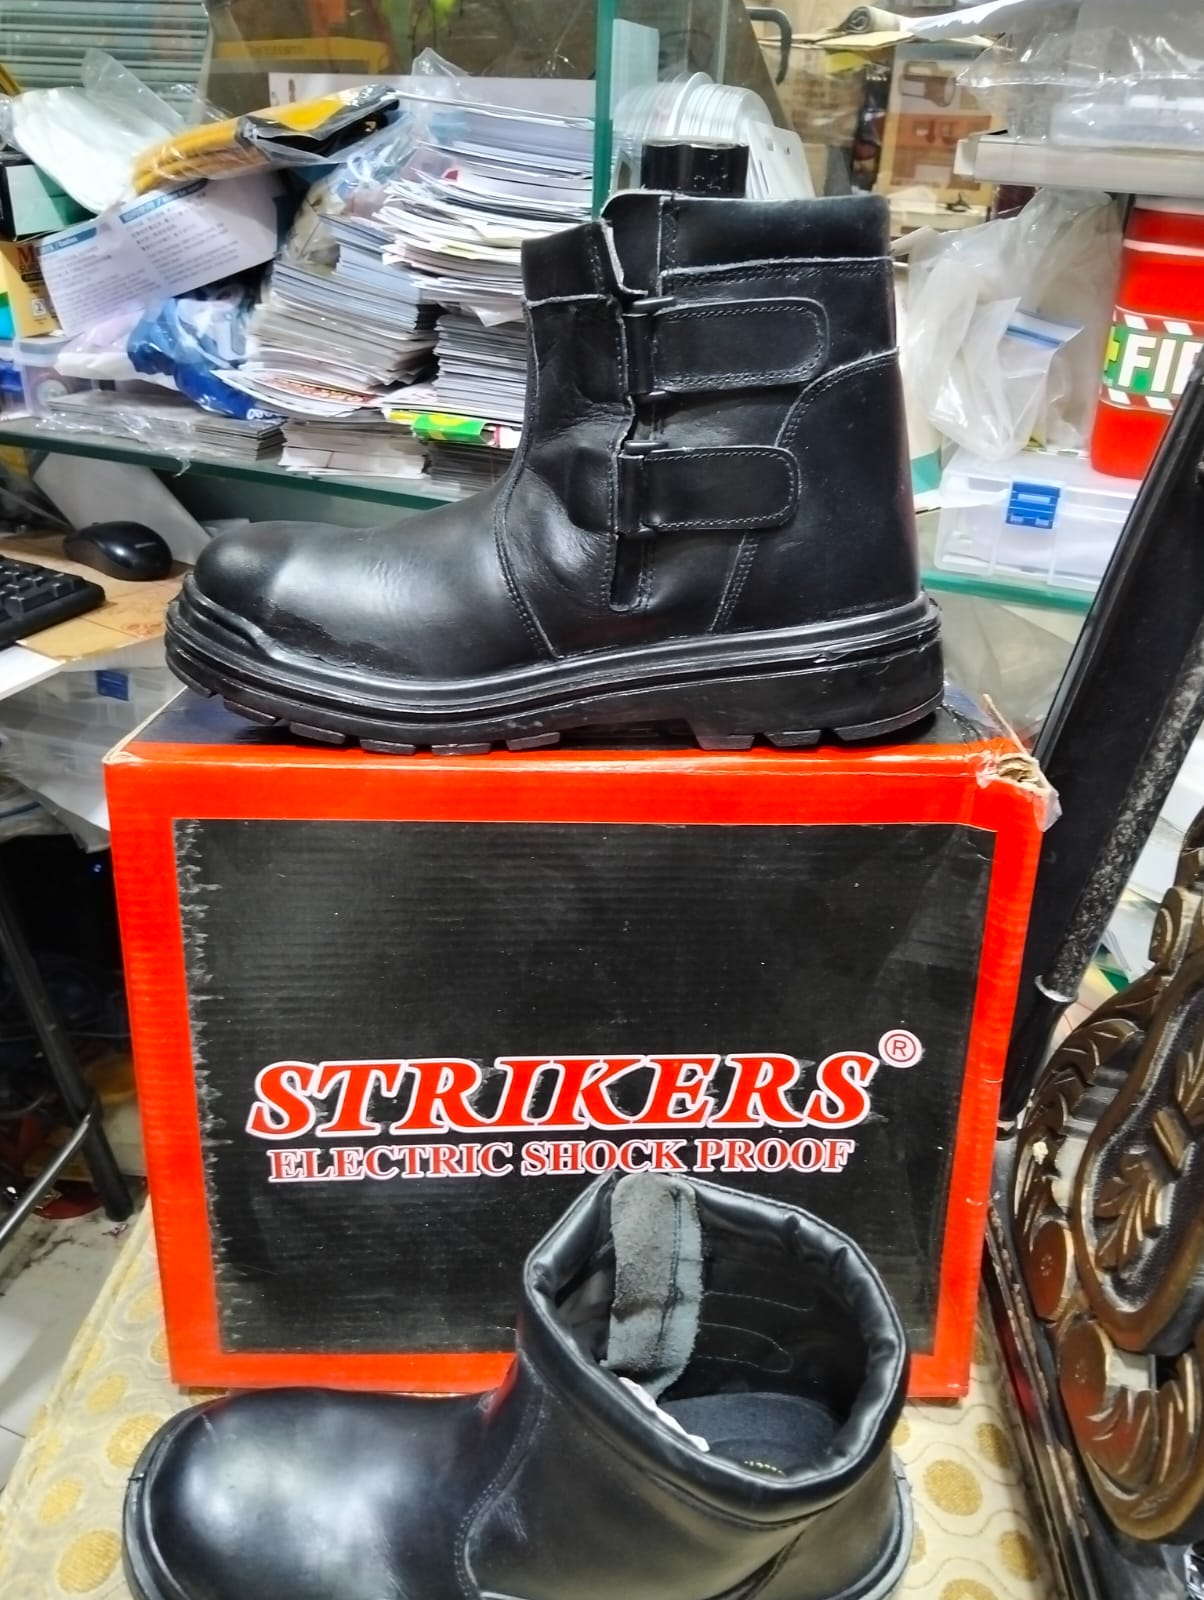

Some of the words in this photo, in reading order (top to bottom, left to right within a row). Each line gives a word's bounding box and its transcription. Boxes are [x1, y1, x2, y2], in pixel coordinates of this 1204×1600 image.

[246, 1051, 880, 1139] STRIKERS
[267, 1142, 512, 1183] ELECTRIC
[521, 1140, 688, 1176] SHOCK
[695, 1137, 855, 1174] PROOF
